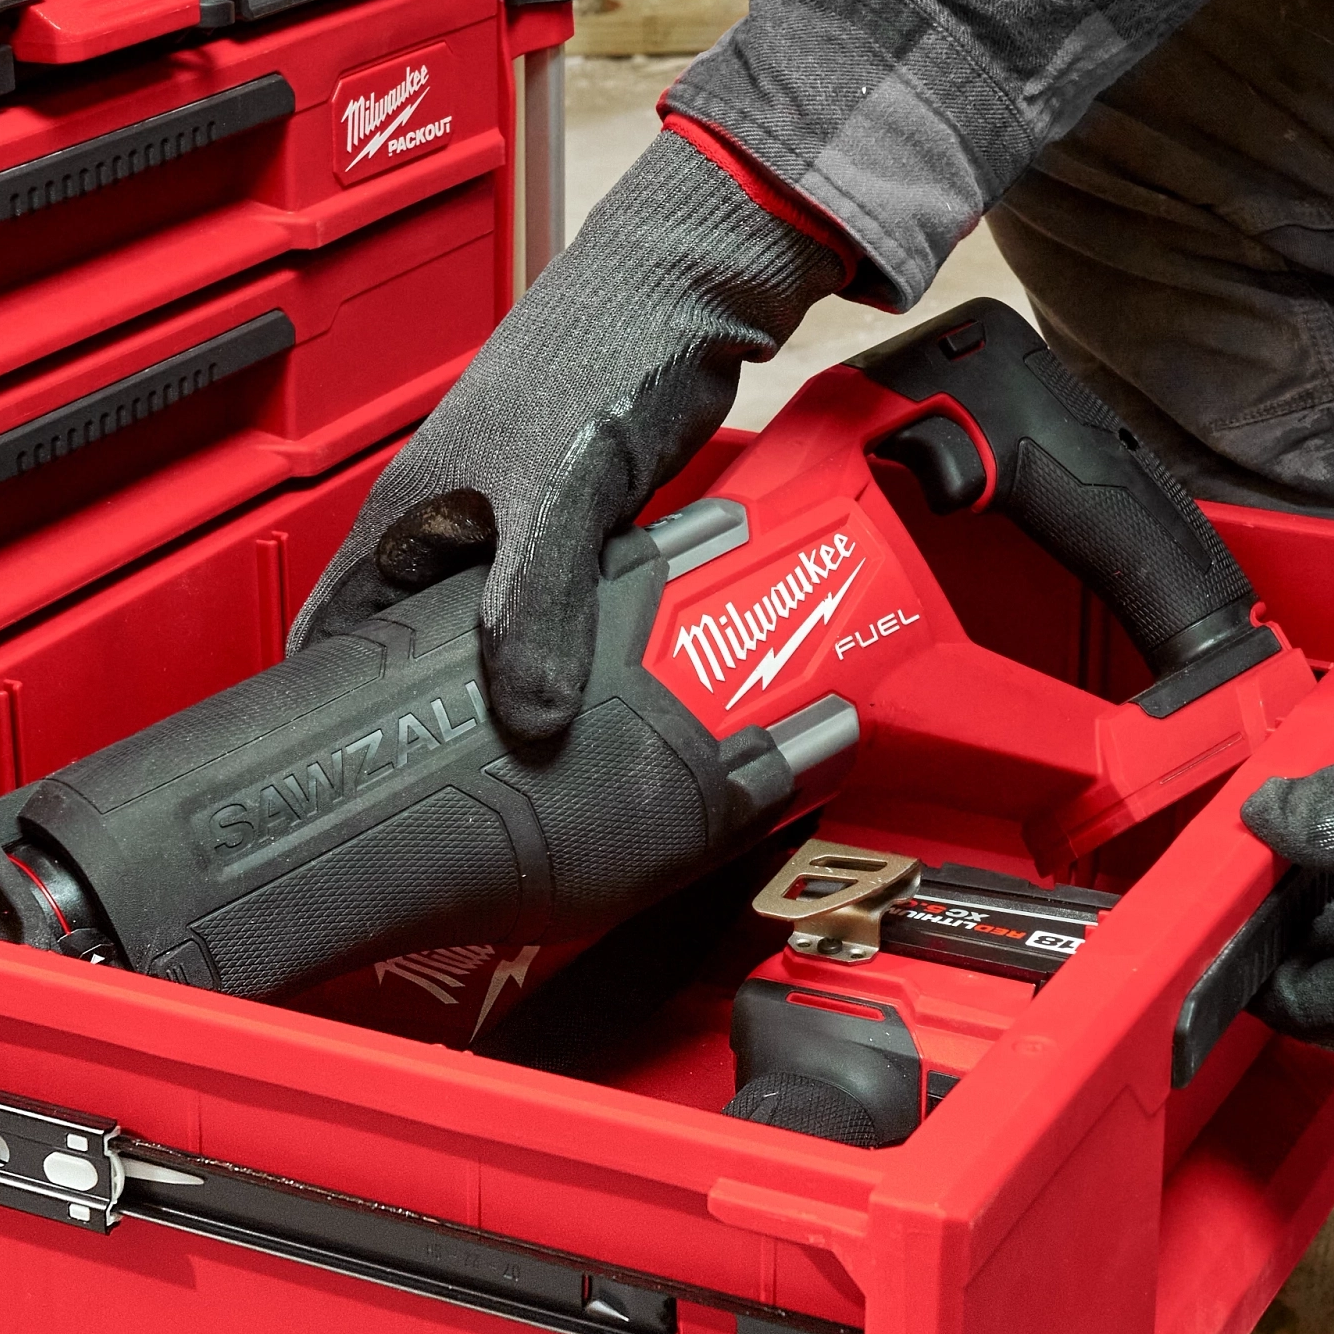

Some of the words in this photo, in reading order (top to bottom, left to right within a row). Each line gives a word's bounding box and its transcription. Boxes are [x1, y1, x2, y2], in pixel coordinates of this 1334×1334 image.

[340, 64, 430, 153] Milwaukee
[387, 115, 453, 157] PACKOUT
[672, 532, 856, 694] Milwaukee
[834, 608, 920, 661] FUEL
